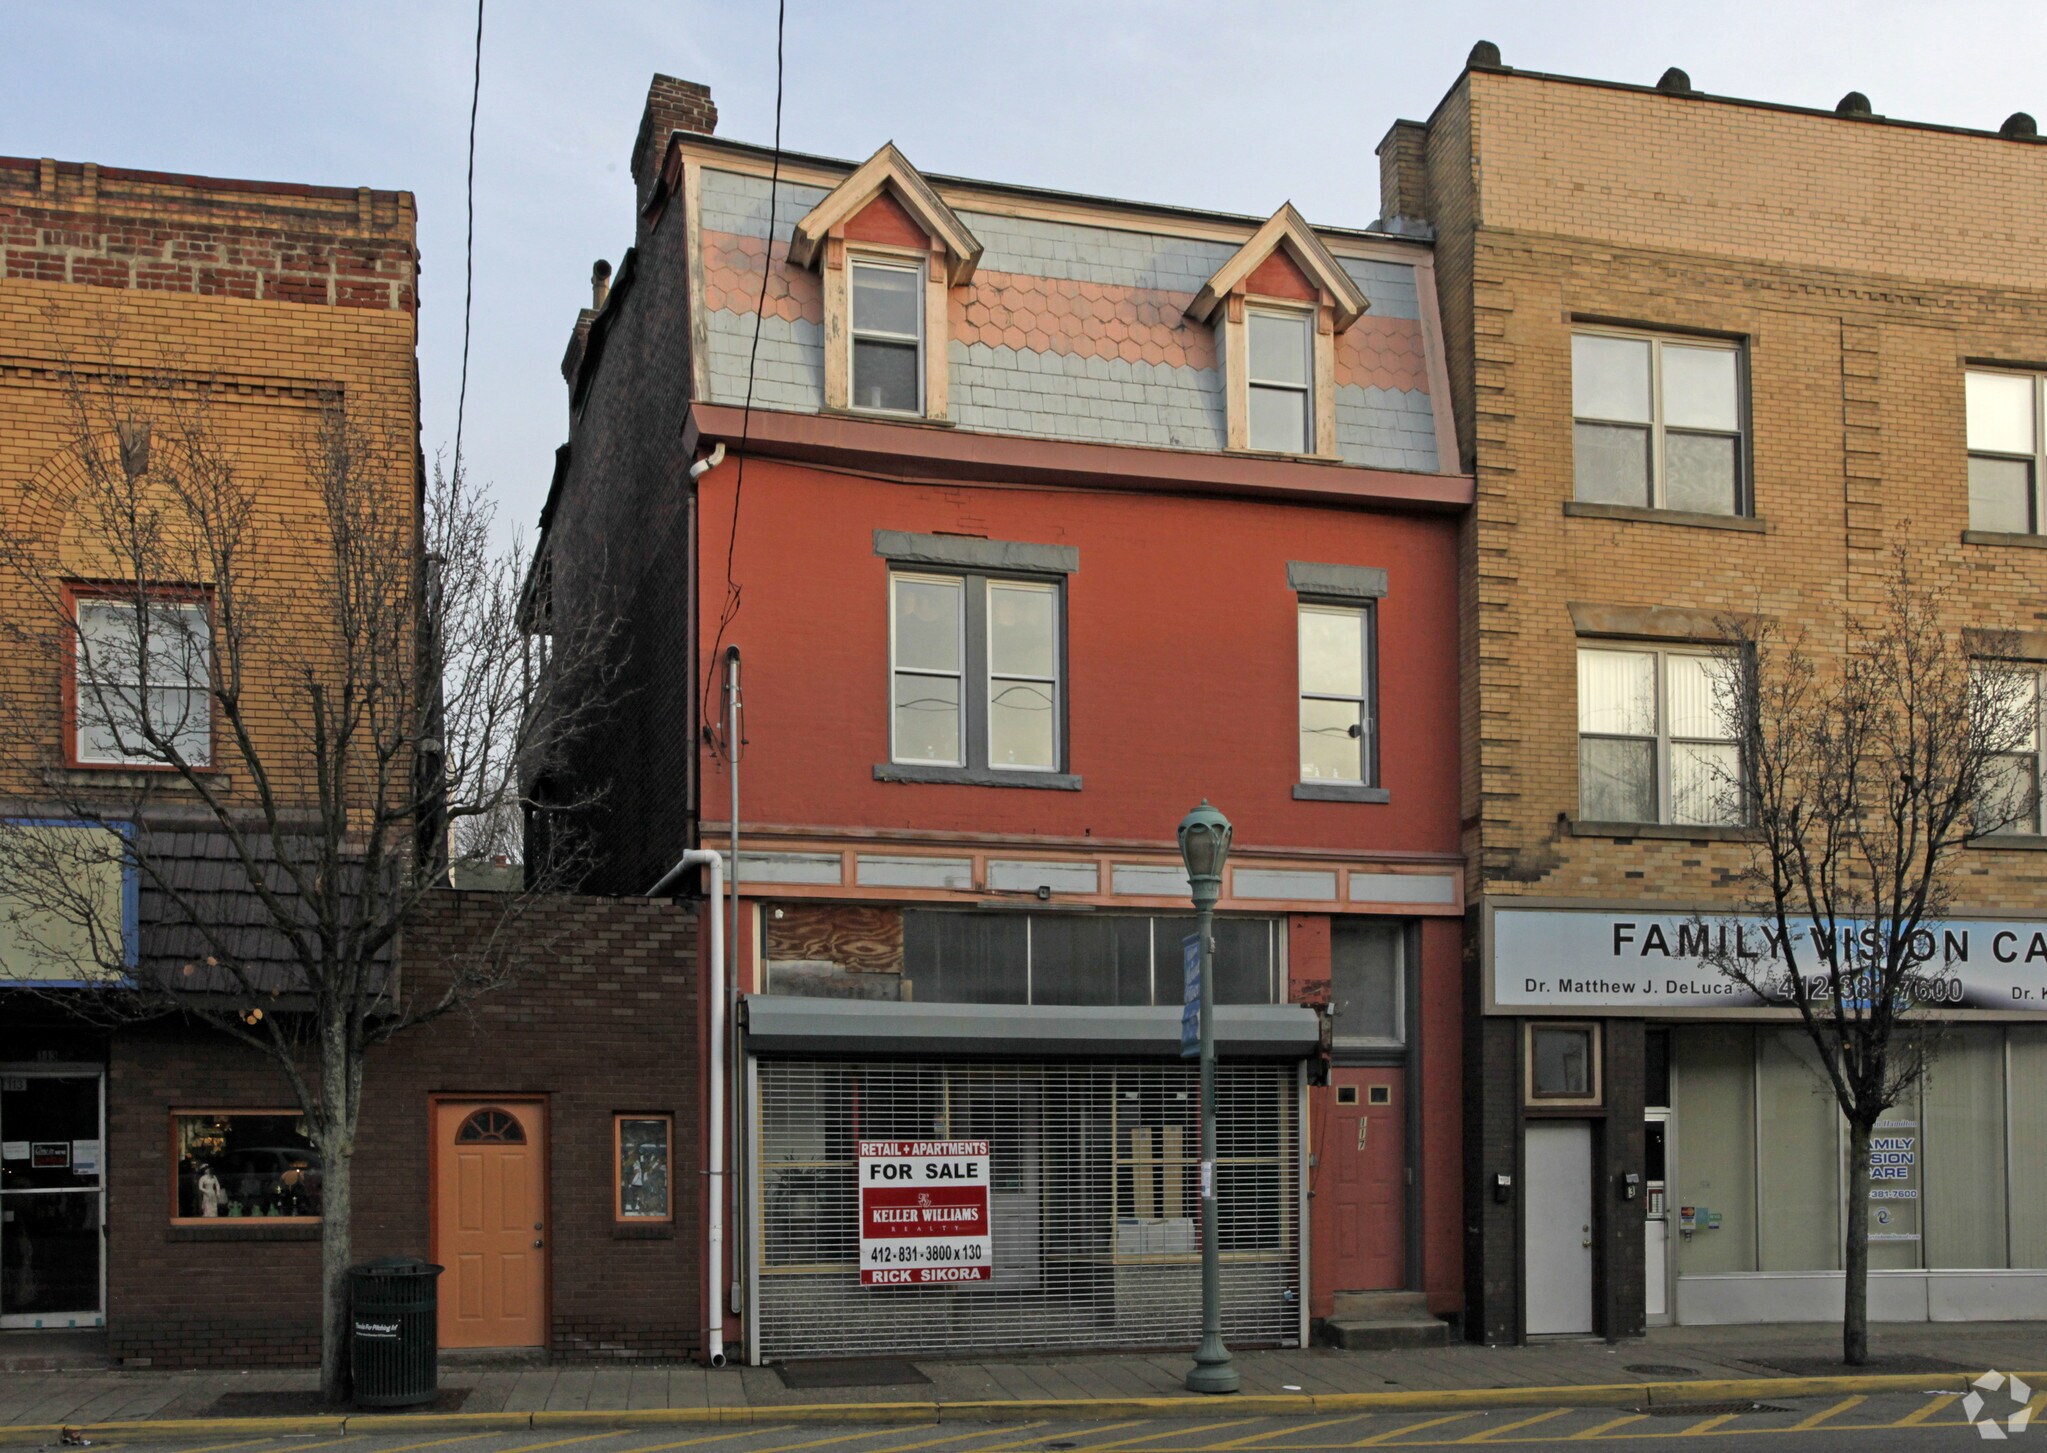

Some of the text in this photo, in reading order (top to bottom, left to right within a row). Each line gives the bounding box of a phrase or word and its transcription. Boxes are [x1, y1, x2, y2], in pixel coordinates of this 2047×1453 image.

[1613, 922, 1788, 960] FAMILY
[1808, 925, 1969, 963] VISON
[1525, 978, 1734, 995] Dr. Matthew J. DeLuca
[2012, 986, 2034, 1000] Dr.
[6, 1079, 24, 1089] 113
[1358, 1117, 1367, 1150] 117
[861, 1142, 902, 1156] RETAIL
[911, 1142, 987, 1156] APARTMENTS
[1869, 1138, 1914, 1149] MILY
[1871, 1153, 1914, 1164] SION
[870, 1162, 979, 1180] FOR SALE
[1870, 1167, 1907, 1178] ARE
[873, 1207, 980, 1223] KELLER WILLIAMS
[891, 1225, 960, 1233] REALTY
[962, 1243, 982, 1261] 130
[872, 1267, 981, 1283] RICK SIKORA
